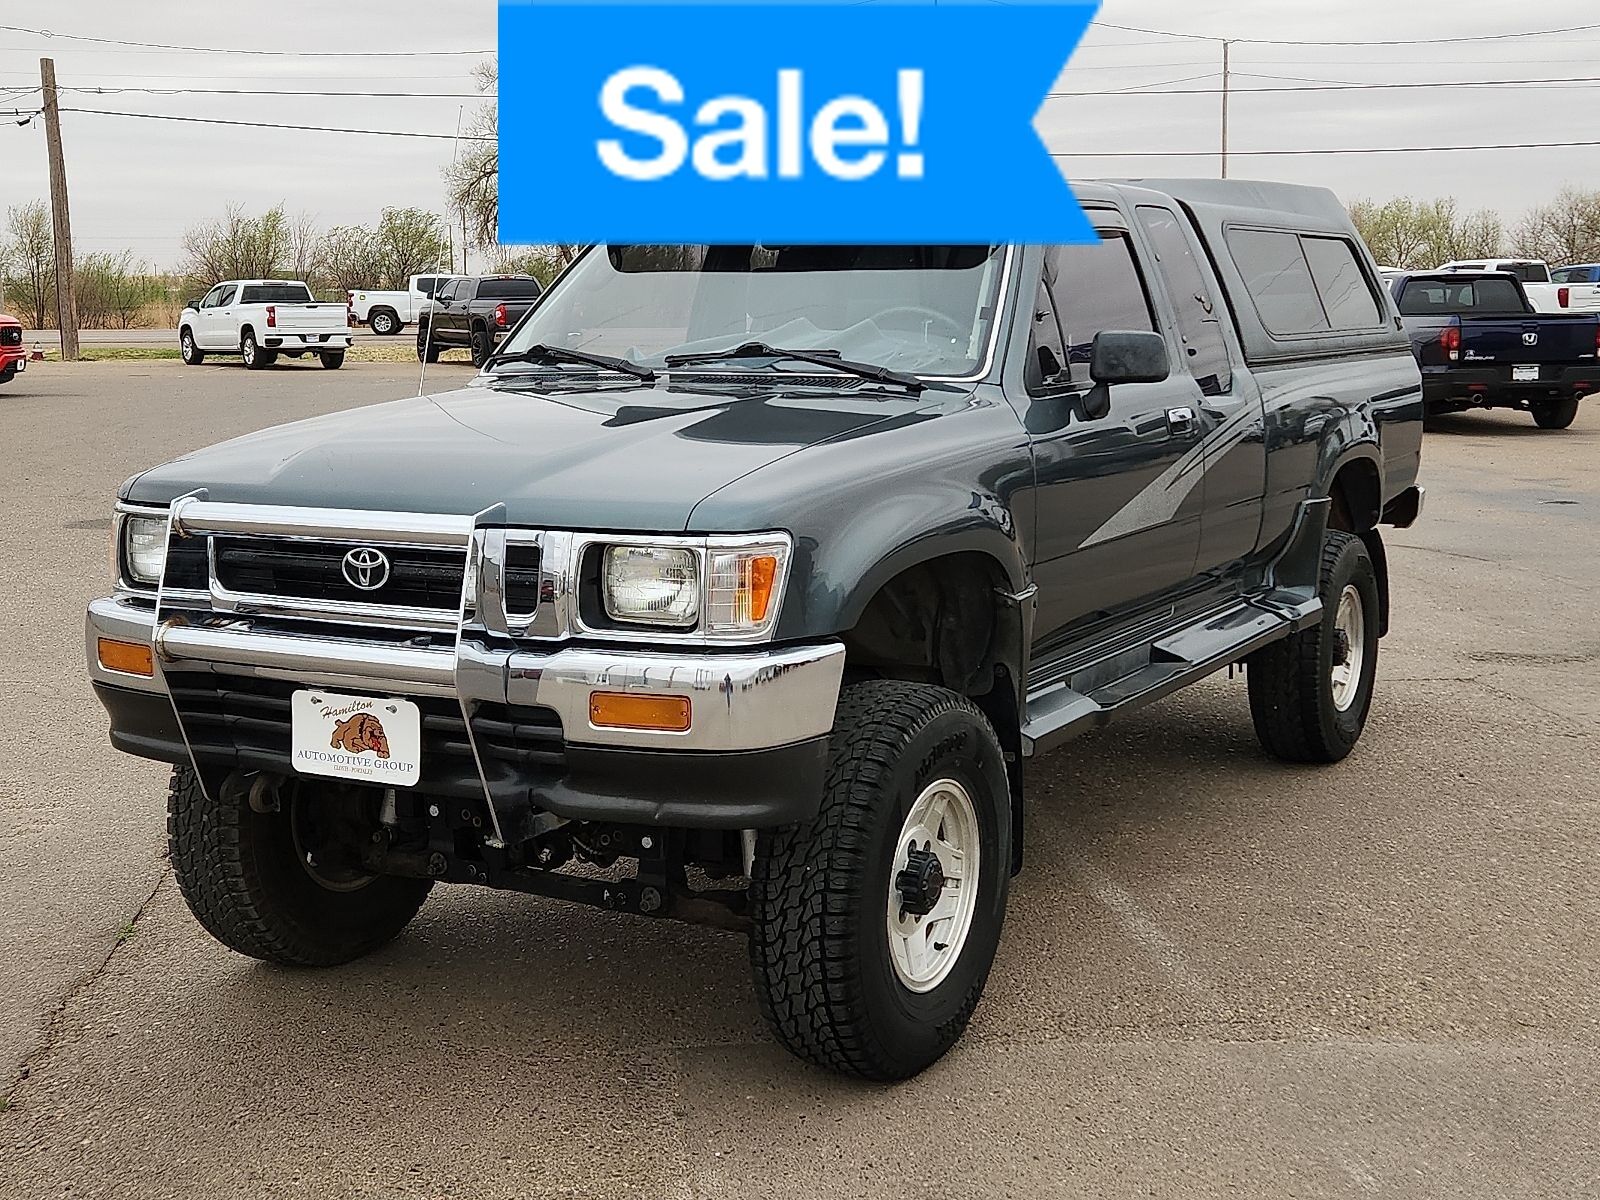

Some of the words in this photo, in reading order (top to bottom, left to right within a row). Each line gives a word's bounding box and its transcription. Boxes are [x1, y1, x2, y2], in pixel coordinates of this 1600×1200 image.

[320, 700, 374, 719] Hamilton
[297, 750, 371, 767] AUTOMOTIVE
[374, 760, 413, 772] GROUP
